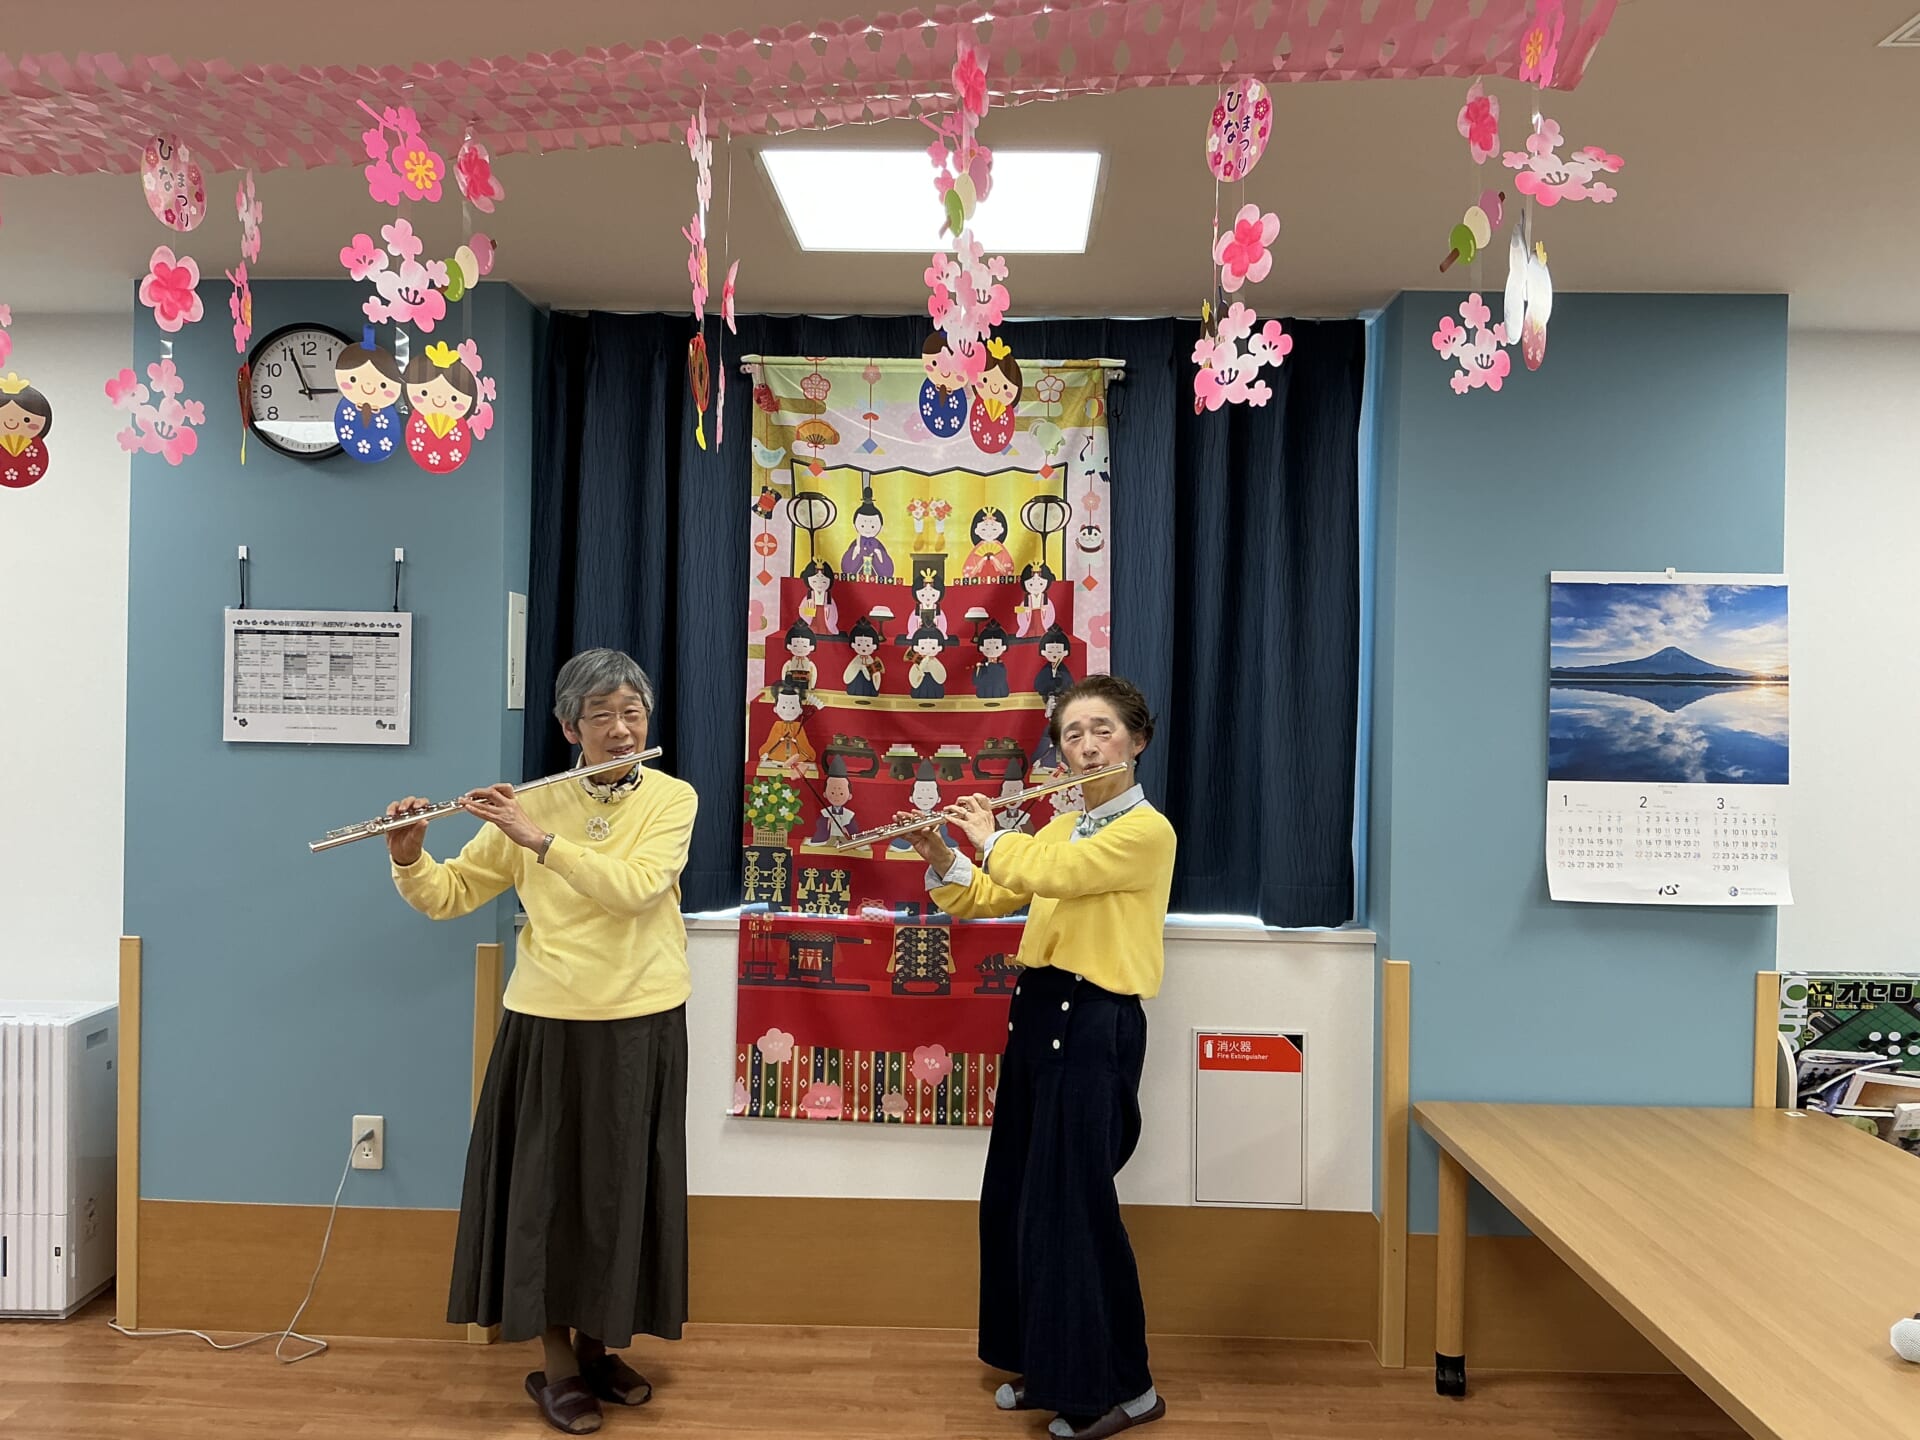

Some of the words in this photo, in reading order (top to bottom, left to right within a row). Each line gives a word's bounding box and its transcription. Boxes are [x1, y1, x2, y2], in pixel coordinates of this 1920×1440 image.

[1224, 91, 1242, 144] ひな
[1238, 115, 1251, 173] まつり
[157, 138, 175, 192] ひな
[176, 173, 189, 227] まつり
[300, 341, 317, 356] 12
[326, 348, 332, 361] 1
[265, 363, 282, 378] 10
[260, 385, 272, 399] 9
[267, 406, 279, 421] 8
[1563, 794, 1568, 807] 1
[1639, 795, 1648, 809] 2
[1716, 796, 1725, 810] 3
[1836, 981, 1914, 1004] オセロ
[1217, 1040, 1252, 1053] 消火器
[1230, 1053, 1269, 1061] Extinguisher
